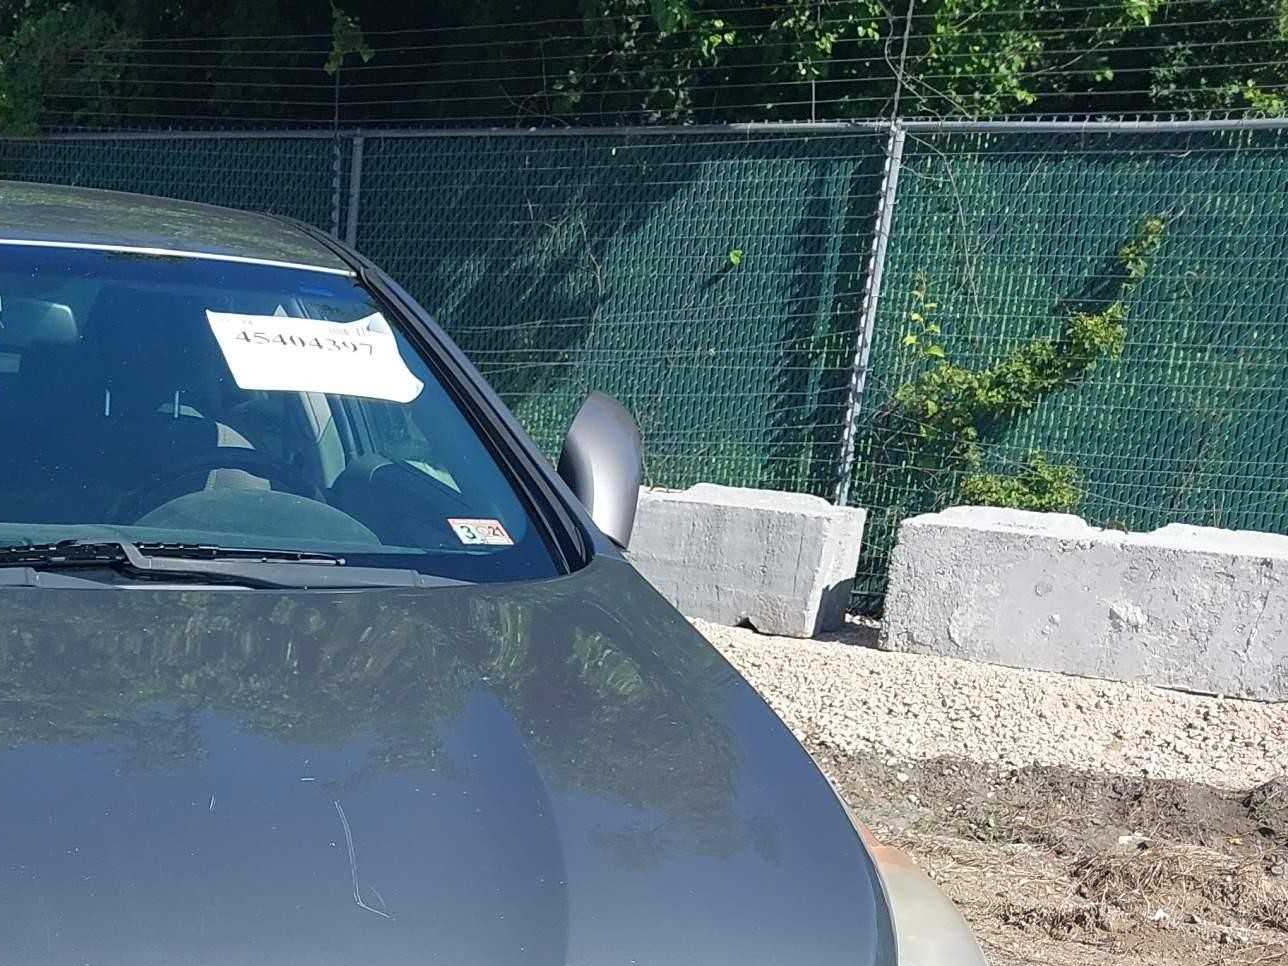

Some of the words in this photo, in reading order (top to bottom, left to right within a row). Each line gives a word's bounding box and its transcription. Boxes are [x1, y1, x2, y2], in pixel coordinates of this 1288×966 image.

[235, 330, 374, 356] 45404397
[459, 525, 477, 540] 3
[487, 525, 505, 537] 21
